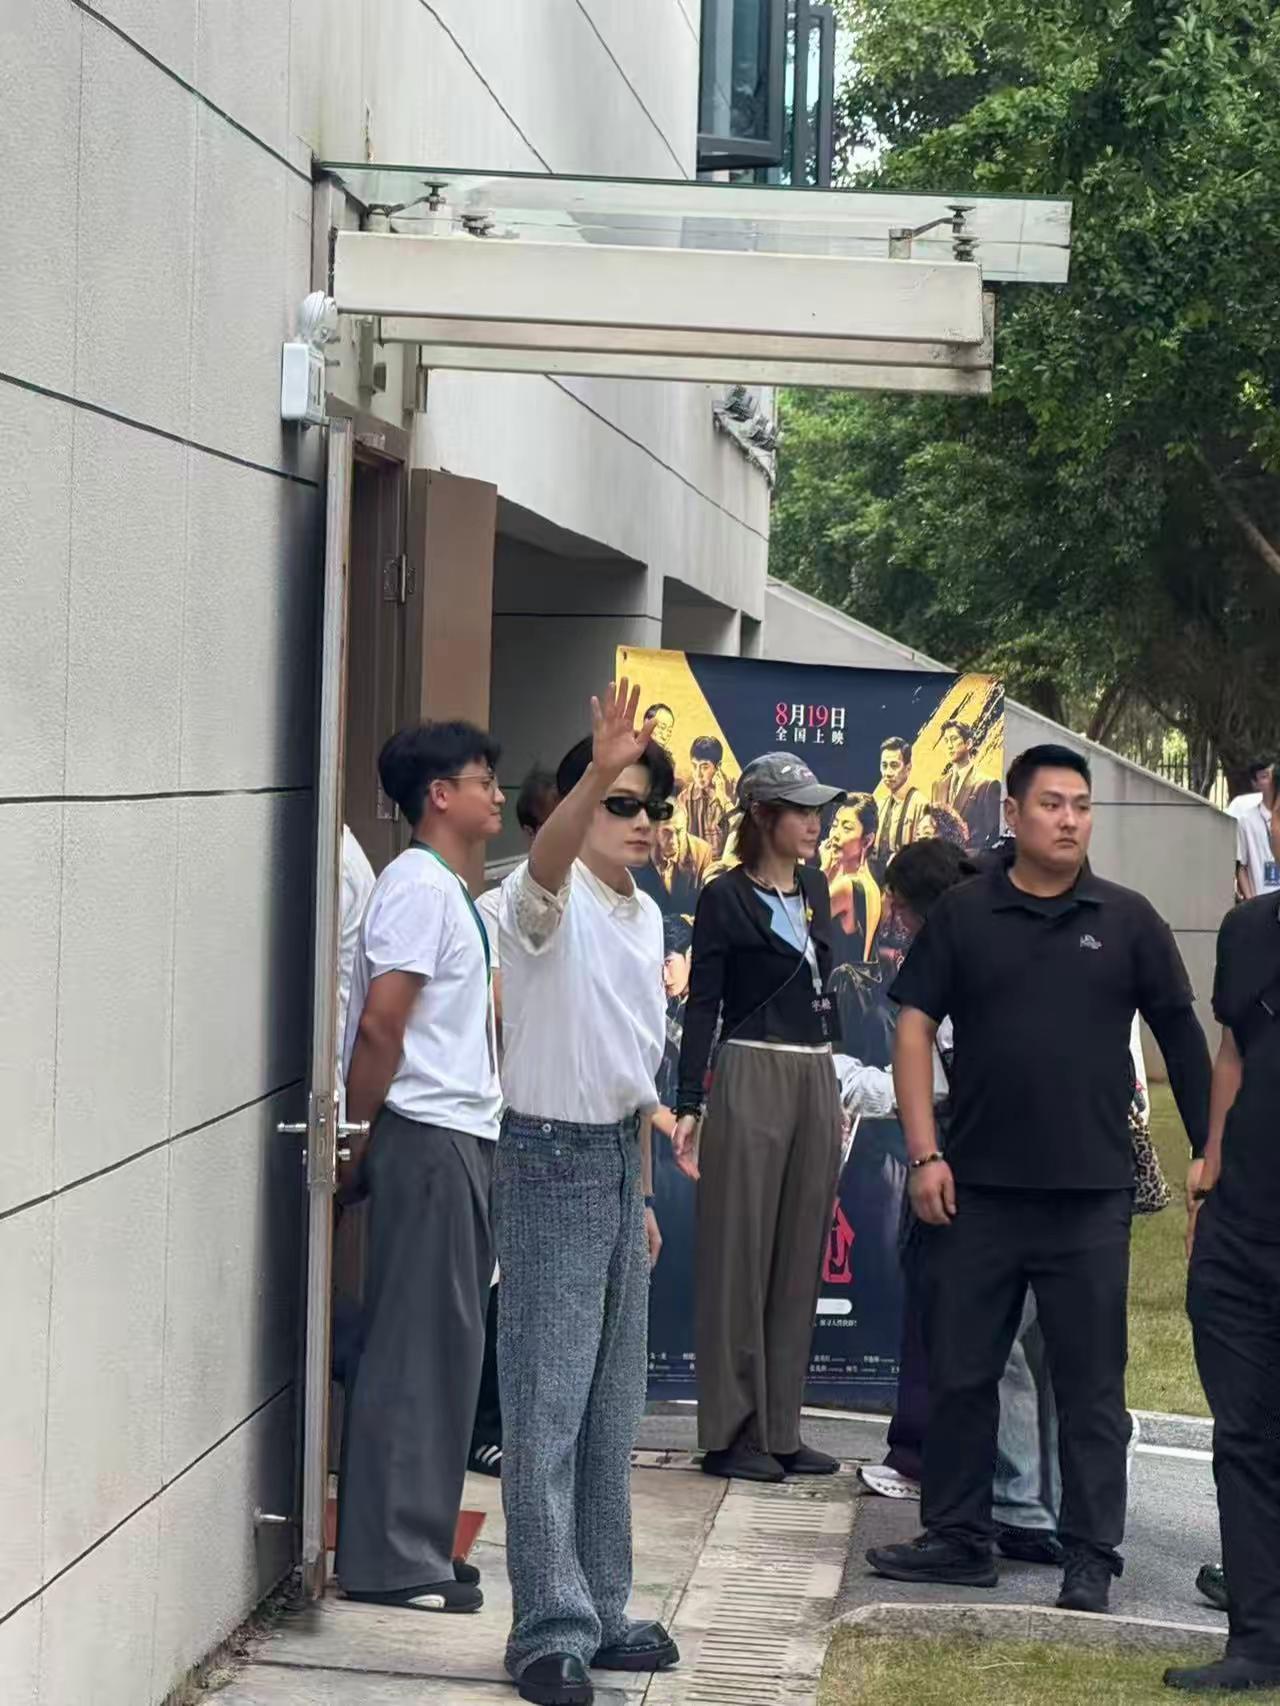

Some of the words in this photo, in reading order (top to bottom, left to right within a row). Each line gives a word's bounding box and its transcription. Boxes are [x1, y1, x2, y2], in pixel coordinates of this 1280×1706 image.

[776, 702, 846, 729] 8月19日
[776, 726, 844, 745] 全国上映
